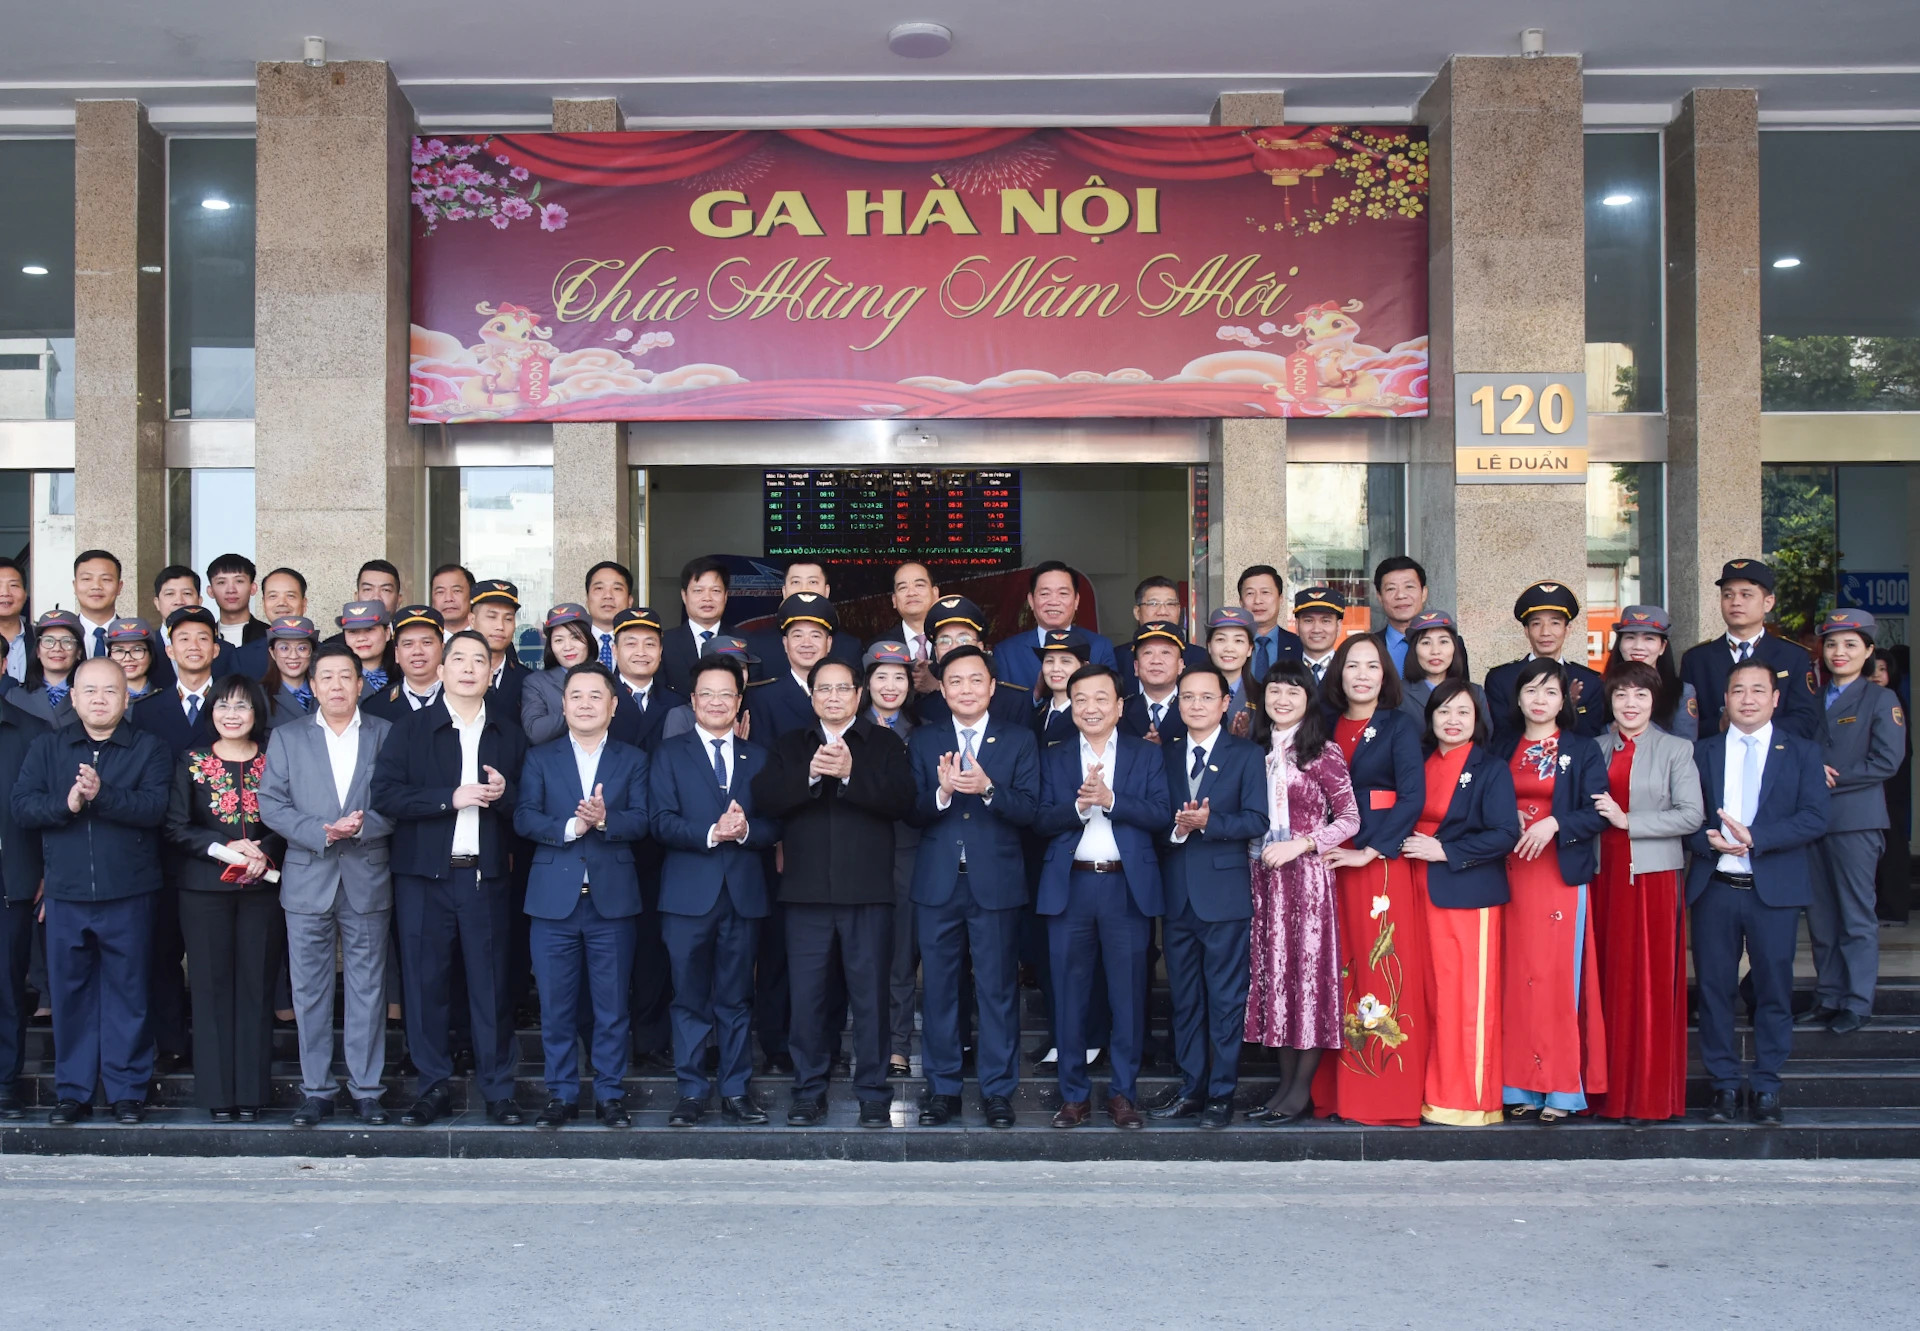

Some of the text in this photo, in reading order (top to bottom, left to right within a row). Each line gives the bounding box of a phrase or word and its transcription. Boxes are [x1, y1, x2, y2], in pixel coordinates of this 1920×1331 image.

[690, 173, 1158, 243] GA HÀ NỘI
[552, 246, 1298, 352] Chúc Mừng Năm Mới
[529, 361, 543, 400] 2025
[1293, 358, 1307, 395] 2025
[1471, 383, 1575, 434] 120
[1477, 451, 1568, 469] LÊ DUẨN
[1865, 578, 1909, 607] 1900
